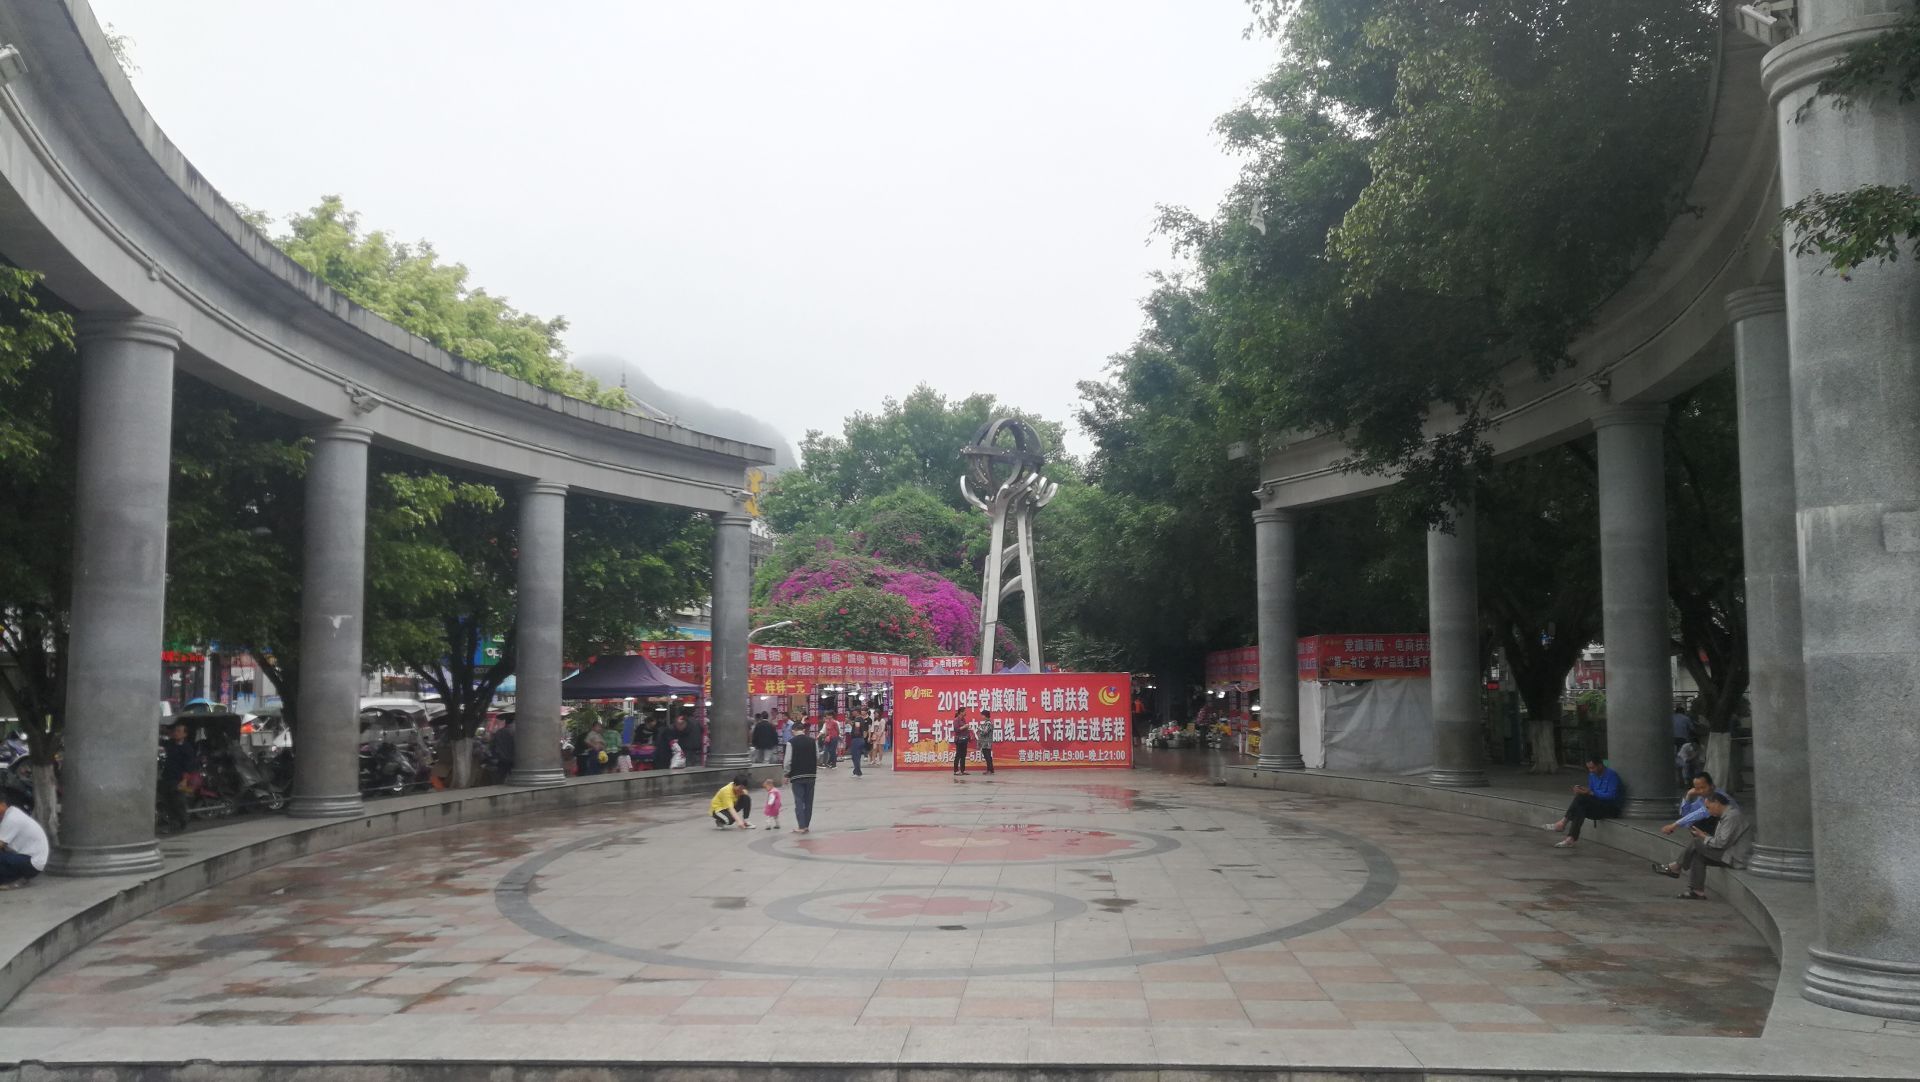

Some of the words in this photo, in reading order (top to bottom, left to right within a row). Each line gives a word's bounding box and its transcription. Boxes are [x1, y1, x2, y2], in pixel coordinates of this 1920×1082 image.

[1329, 655, 1430, 669] “第一书记”农产品线上线下
[938, 687, 1089, 712] 2019年党旗领航·电商扶贫
